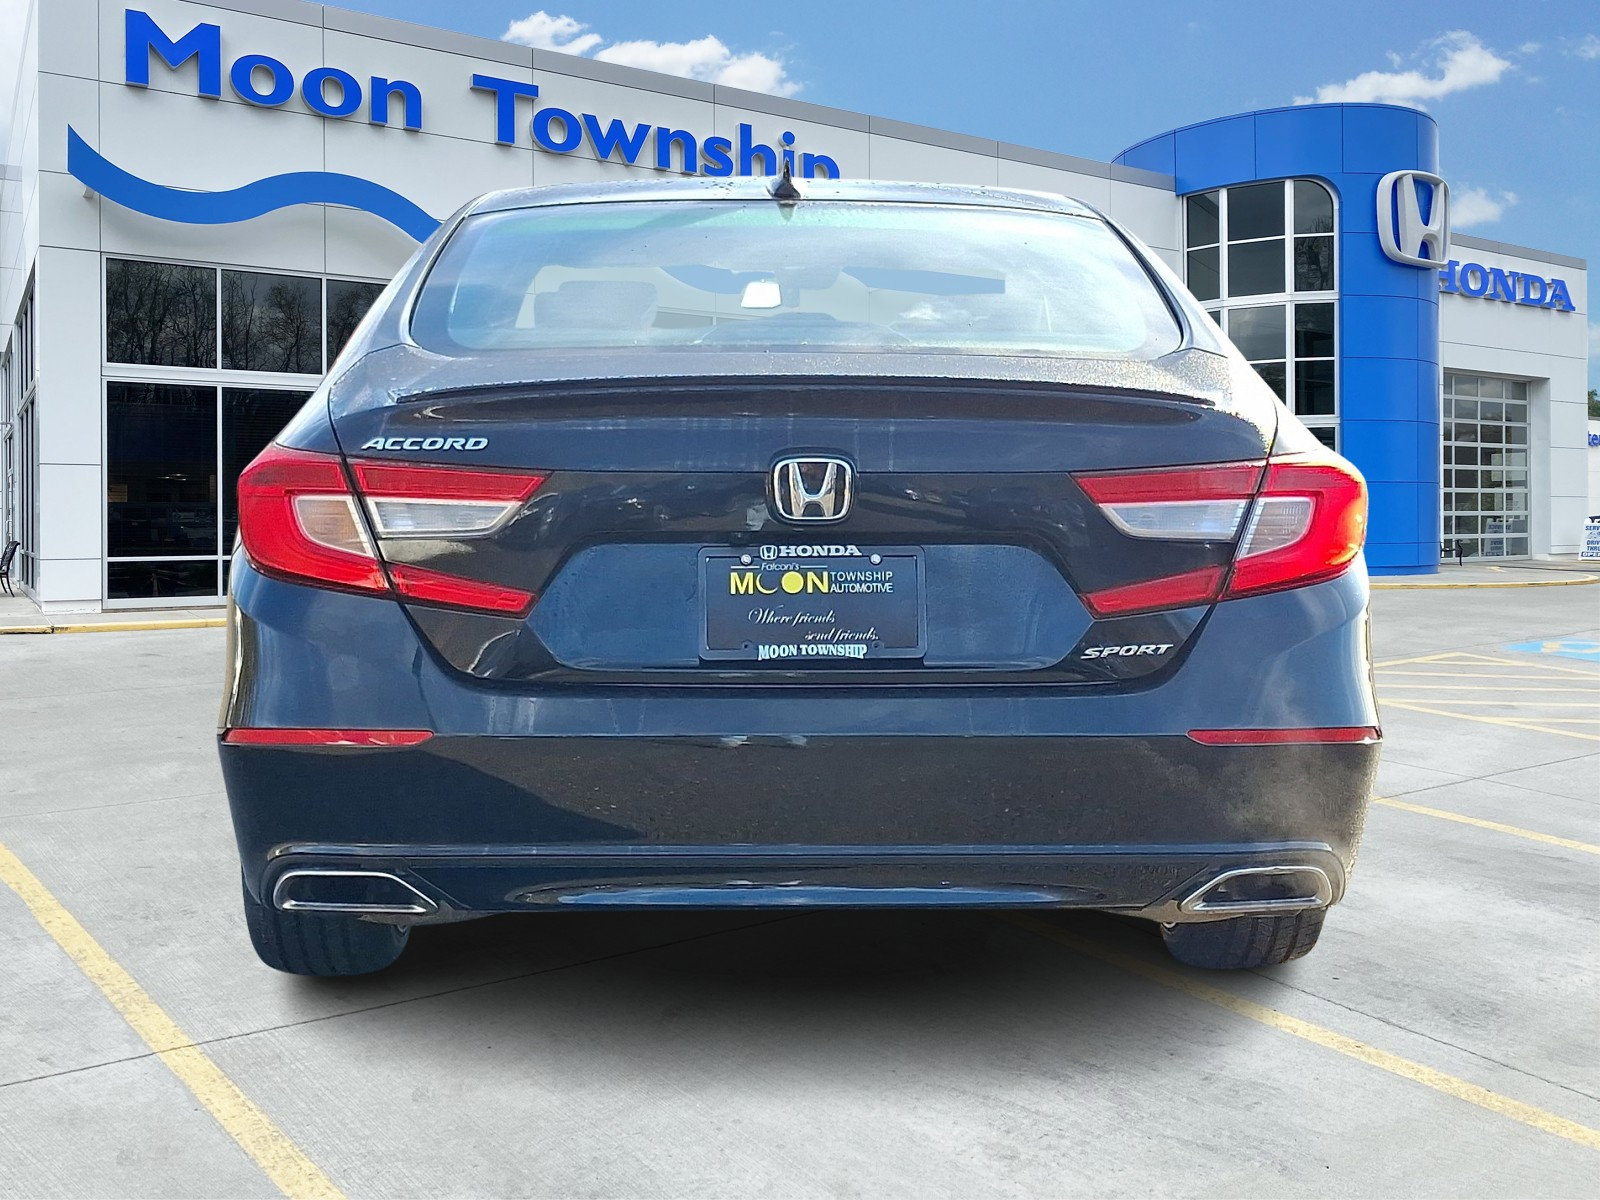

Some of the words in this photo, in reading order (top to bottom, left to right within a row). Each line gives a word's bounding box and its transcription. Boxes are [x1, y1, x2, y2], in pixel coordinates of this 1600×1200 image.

[125, 9, 422, 131] Moon
[1438, 259, 1576, 312] HONDA
[361, 437, 489, 451] ACCORD
[779, 545, 862, 557] HONDA
[761, 562, 800, 571] Falconi's
[730, 571, 829, 594] MOON
[830, 571, 893, 582] TOWNSHIP
[830, 583, 894, 593] AUTOMOTIVE
[748, 605, 793, 624] Where
[792, 610, 835, 627] friends
[805, 627, 836, 641] send
[758, 645, 798, 660] MOON
[800, 644, 867, 659] TOWNSHIP
[1080, 644, 1174, 660] SPORT
